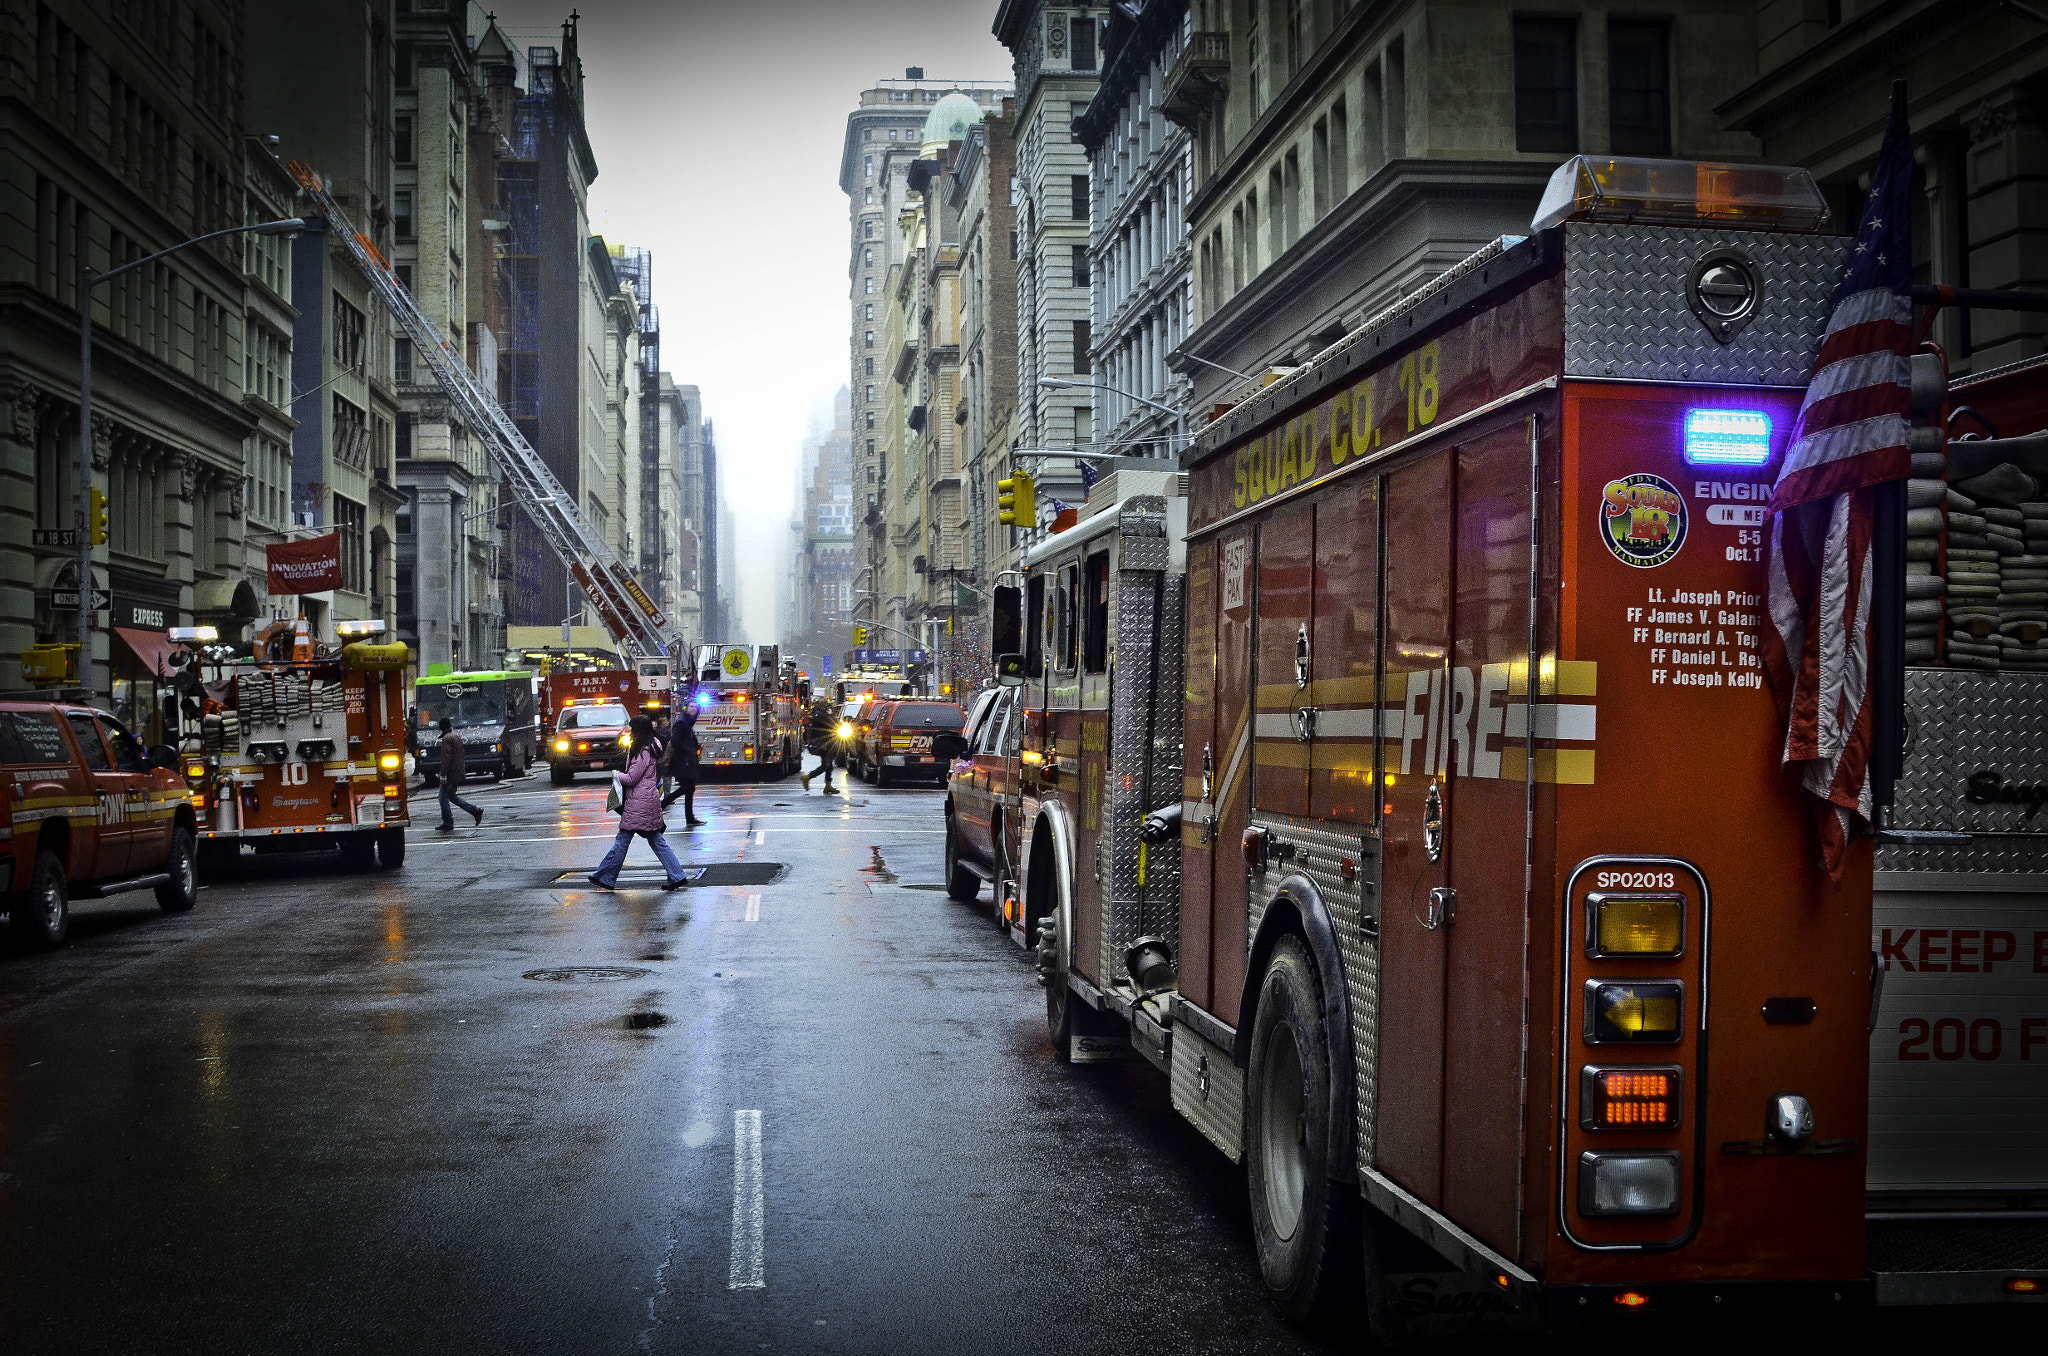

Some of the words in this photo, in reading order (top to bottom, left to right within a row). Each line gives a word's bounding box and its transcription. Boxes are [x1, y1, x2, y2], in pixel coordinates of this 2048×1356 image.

[1235, 409, 1318, 509] SQUAD
[1330, 379, 1381, 465] CO.
[1400, 339, 1440, 433] 18
[1628, 474, 1660, 487] FDNY
[1694, 480, 1774, 501] ENGIN
[1628, 506, 1670, 541] 18
[1722, 509, 1734, 521] IN
[1744, 509, 1765, 522] ME
[36, 532, 45, 544] W
[49, 532, 59, 544] 18
[63, 532, 74, 544] ST
[1226, 544, 1244, 574] FAST
[1613, 545, 1675, 567] MANHATTAN
[1725, 546, 1752, 562] Oct.
[1754, 547, 1764, 562] 1
[271, 558, 337, 572] INNOVATION
[283, 569, 326, 579] LUGGAGE
[58, 594, 76, 604] ONE
[1227, 575, 1242, 604] PAK
[1648, 587, 1667, 603] Lt.
[1671, 588, 1722, 607] Joseph
[624, 579, 655, 616] LADDER
[651, 612, 664, 626] 3
[133, 607, 164, 627] EXPRESS
[1627, 607, 1643, 622] FF
[1647, 608, 1693, 624] James
[1699, 609, 1712, 625] V.
[1633, 627, 1649, 643] FF
[1655, 628, 1711, 645] Bernard
[1716, 630, 1730, 646] A.
[1651, 648, 1667, 664] FF
[1672, 649, 1716, 665] Daniel
[1721, 651, 1733, 666] L.
[573, 676, 610, 687] F.D.N.Y.
[650, 678, 657, 688] 5
[1652, 669, 1668, 684] FF
[1672, 670, 1722, 688] Joseph
[1728, 672, 1762, 690] Kelly
[710, 715, 735, 726] FDNY
[1400, 662, 1510, 779] FIRE
[909, 735, 934, 748] FDN
[279, 762, 309, 786] 10
[99, 793, 125, 826] FDNY
[1881, 928, 2017, 973] KEEP
[1898, 1017, 2002, 1061] 200
[2020, 1017, 2048, 1061] F
